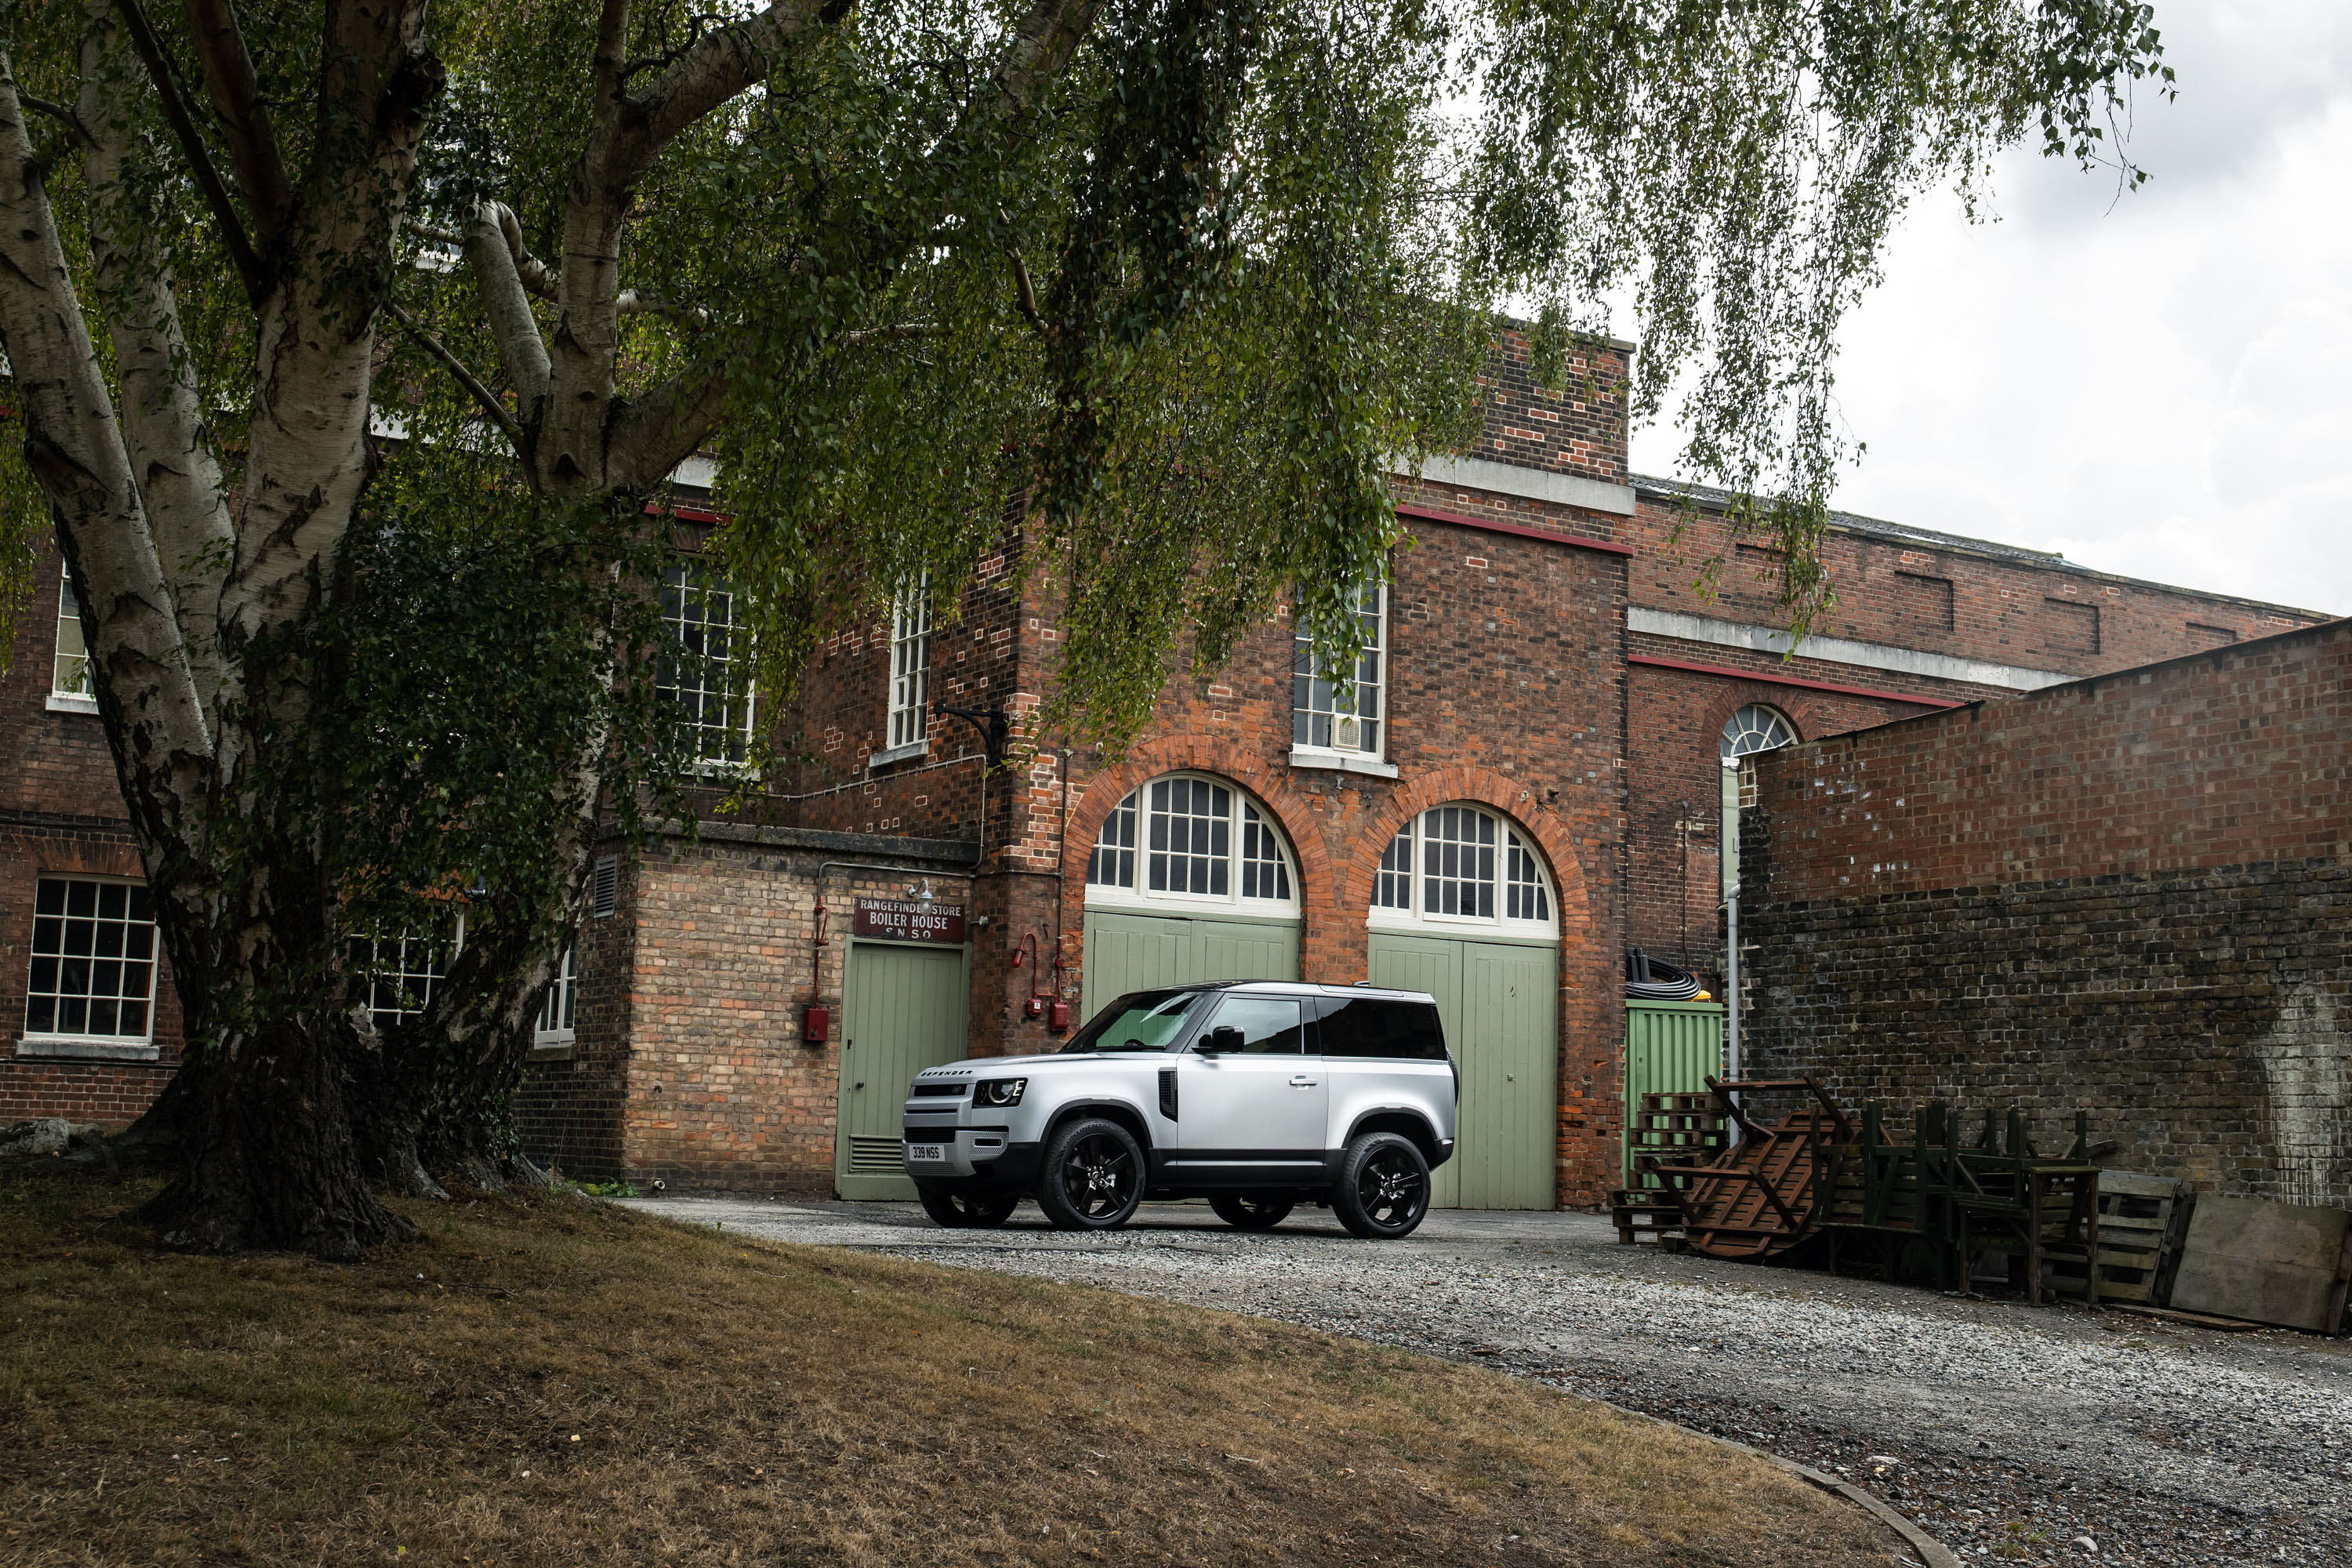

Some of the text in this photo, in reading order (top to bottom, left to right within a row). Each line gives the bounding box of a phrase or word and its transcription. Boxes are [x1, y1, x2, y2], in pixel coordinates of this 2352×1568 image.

[861, 899, 961, 916] RANGEFINDE STORE
[870, 912, 948, 930] BOILER HOUSE
[913, 1146, 939, 1159] 339 NSS
